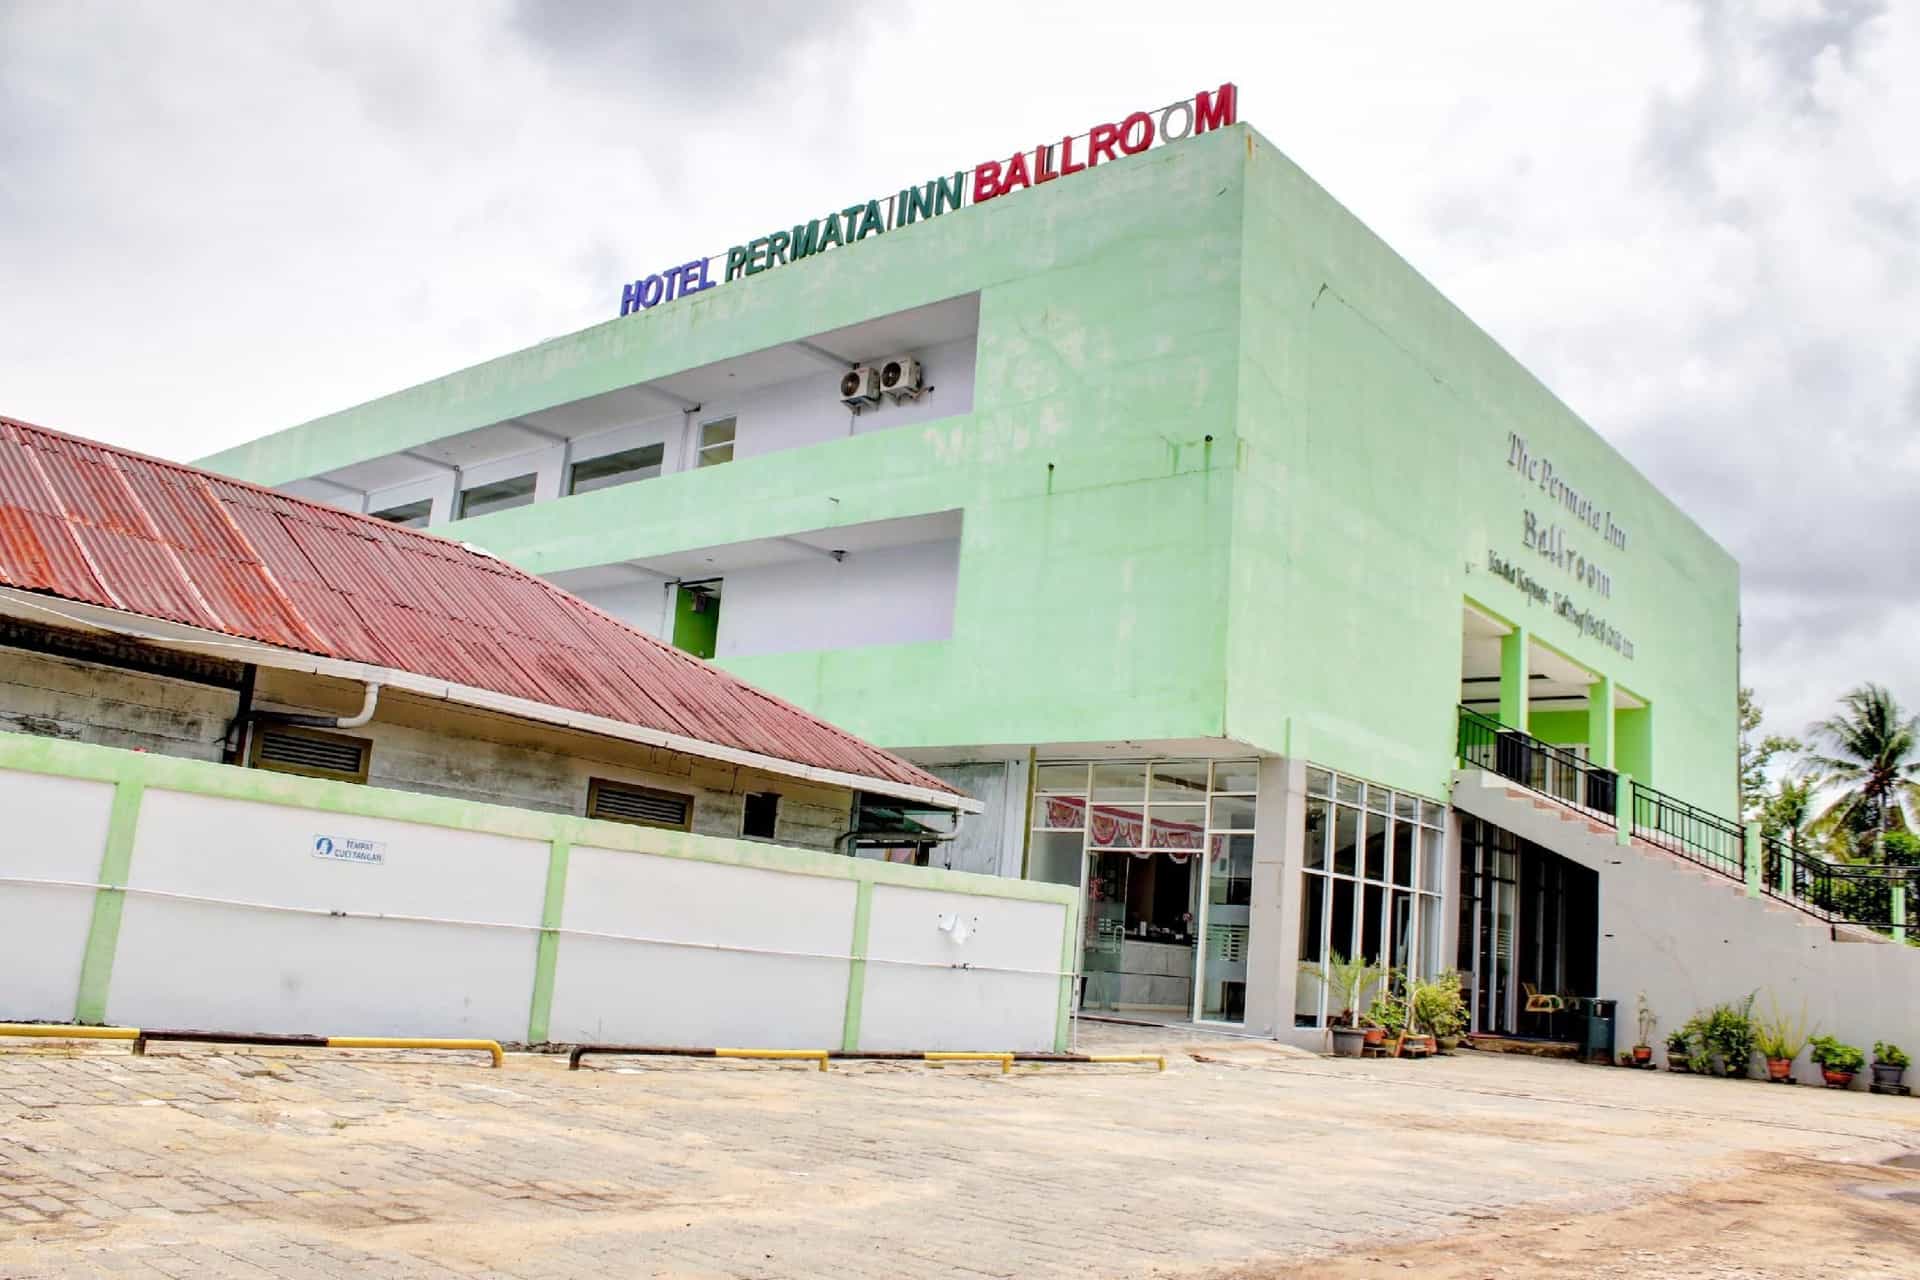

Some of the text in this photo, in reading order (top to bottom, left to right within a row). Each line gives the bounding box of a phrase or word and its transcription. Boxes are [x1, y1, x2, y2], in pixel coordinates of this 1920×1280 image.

[620, 82, 1238, 316] HOTEL PERMATA INN BALLROOM
[1507, 431, 1537, 481] The
[1539, 457, 1601, 532] Permata
[346, 839, 374, 850] TEMPAT
